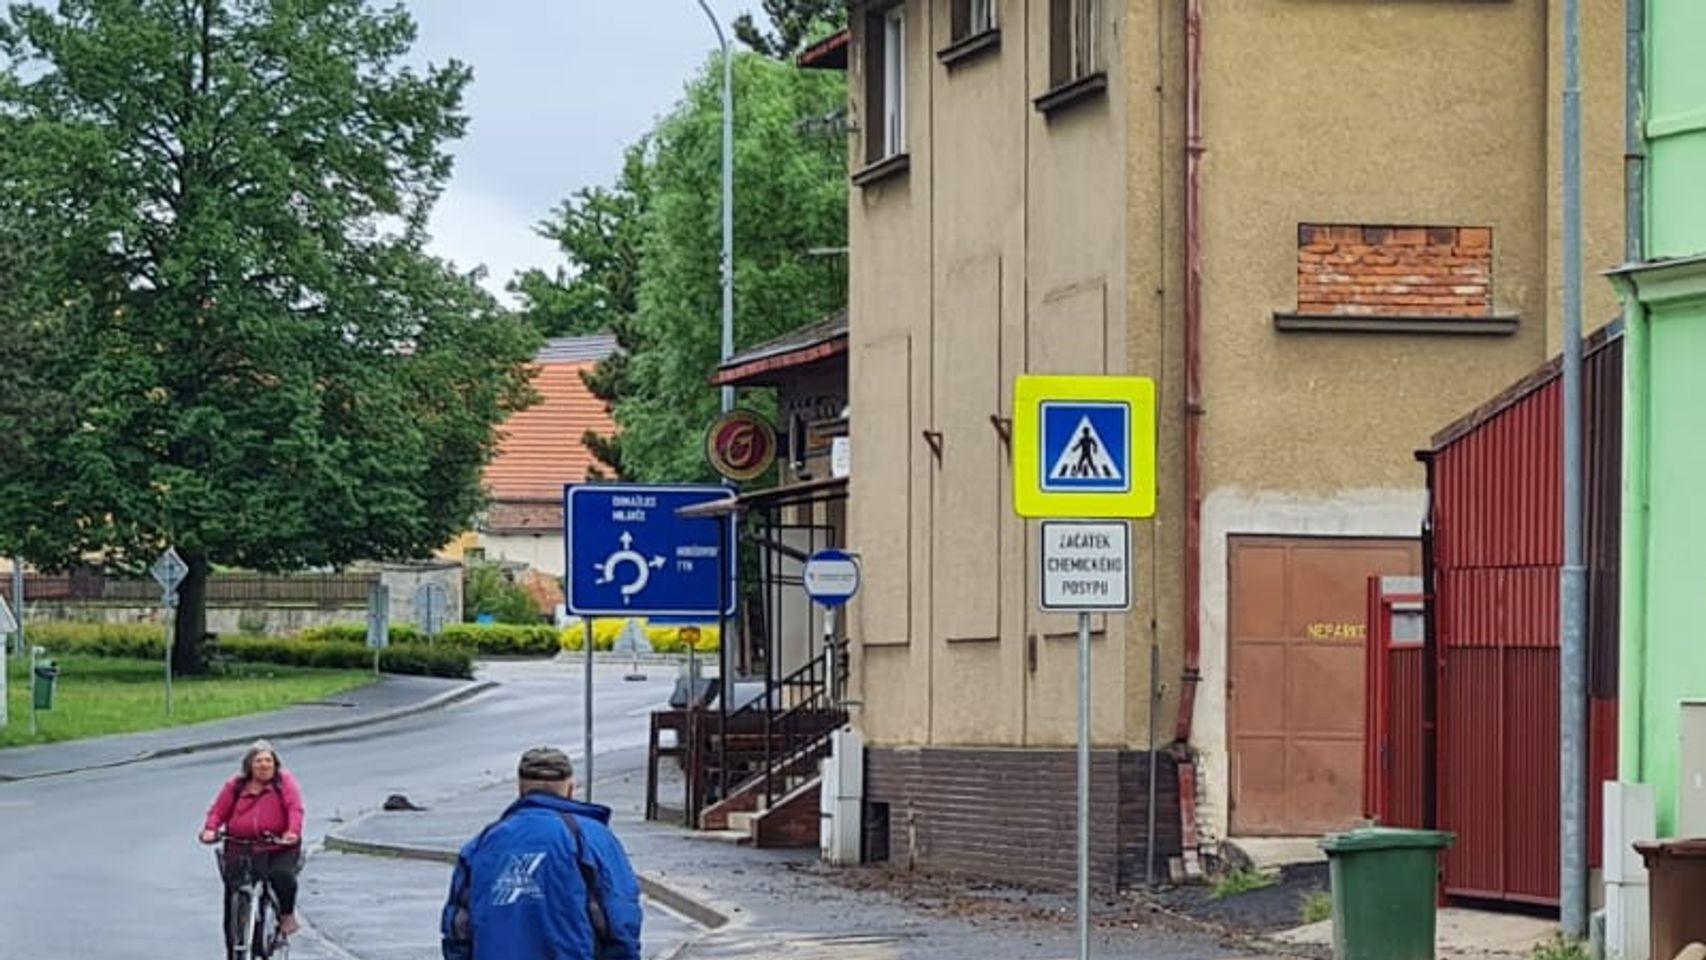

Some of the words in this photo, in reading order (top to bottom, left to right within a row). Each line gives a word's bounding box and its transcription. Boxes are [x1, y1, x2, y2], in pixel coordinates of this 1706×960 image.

[1059, 532, 1111, 549] ZAČÁTEK
[1047, 554, 1122, 572] CHEMICKÉHO
[1062, 580, 1109, 596] POSYPU
